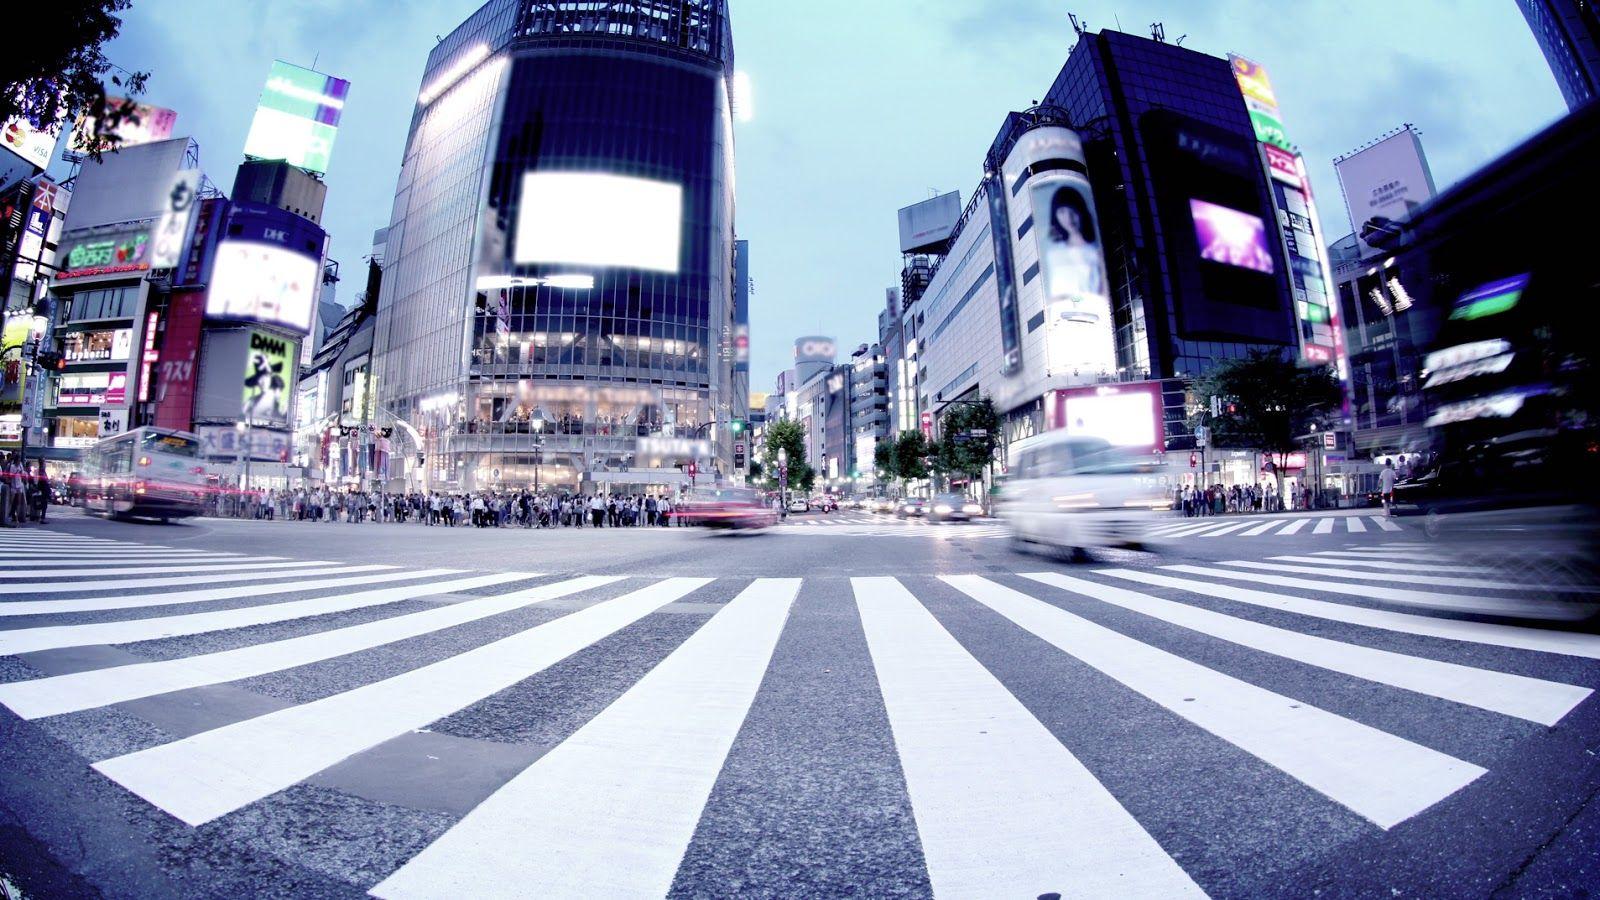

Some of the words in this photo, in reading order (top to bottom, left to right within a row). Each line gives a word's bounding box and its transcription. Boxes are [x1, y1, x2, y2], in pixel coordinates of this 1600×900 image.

[33, 145, 49, 158] VISA
[263, 226, 290, 241] DHC
[251, 332, 286, 358] DMM
